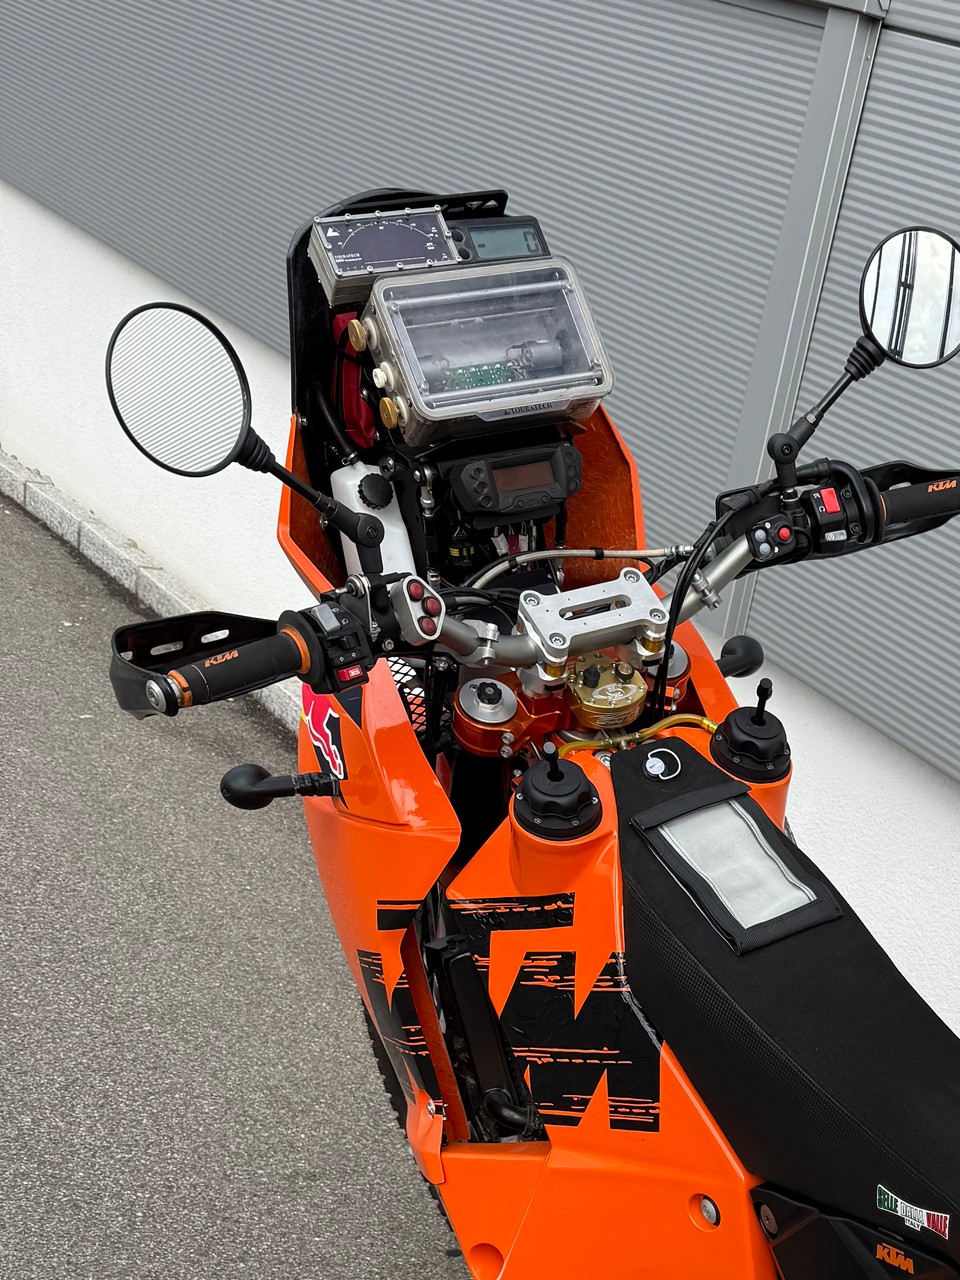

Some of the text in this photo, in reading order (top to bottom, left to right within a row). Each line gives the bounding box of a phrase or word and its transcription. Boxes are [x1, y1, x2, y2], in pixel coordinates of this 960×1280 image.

[511, 402, 553, 415] TOURATECH
[927, 479, 957, 493] KTM
[204, 650, 239, 668] KTM
[877, 1186, 949, 1239] SELLE DALLA VALLE
[905, 1218, 921, 1231] ITALY
[876, 1243, 915, 1275] KTM
